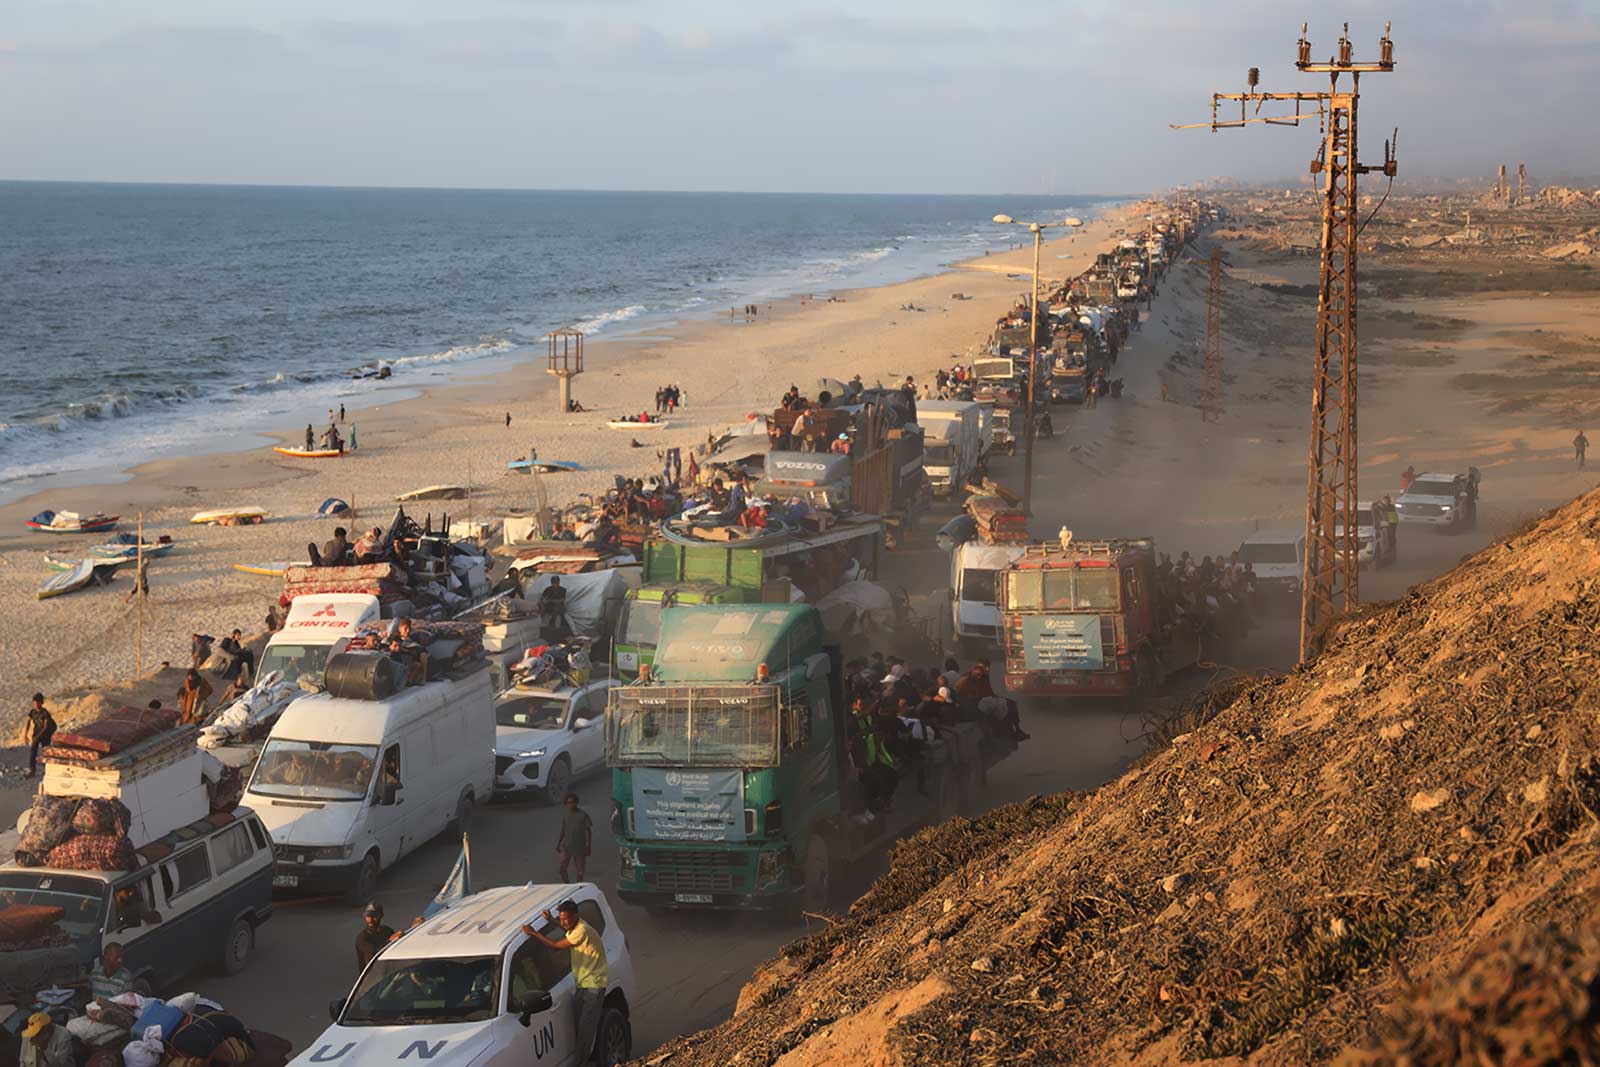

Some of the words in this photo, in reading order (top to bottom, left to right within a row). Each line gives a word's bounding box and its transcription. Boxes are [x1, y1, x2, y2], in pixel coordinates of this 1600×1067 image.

[776, 462, 826, 470] VOLVO
[656, 800, 669, 808] This
[427, 919, 505, 936] UN
[533, 1021, 555, 1060] UN
[309, 1042, 357, 1063] U
[397, 1040, 449, 1059] N
